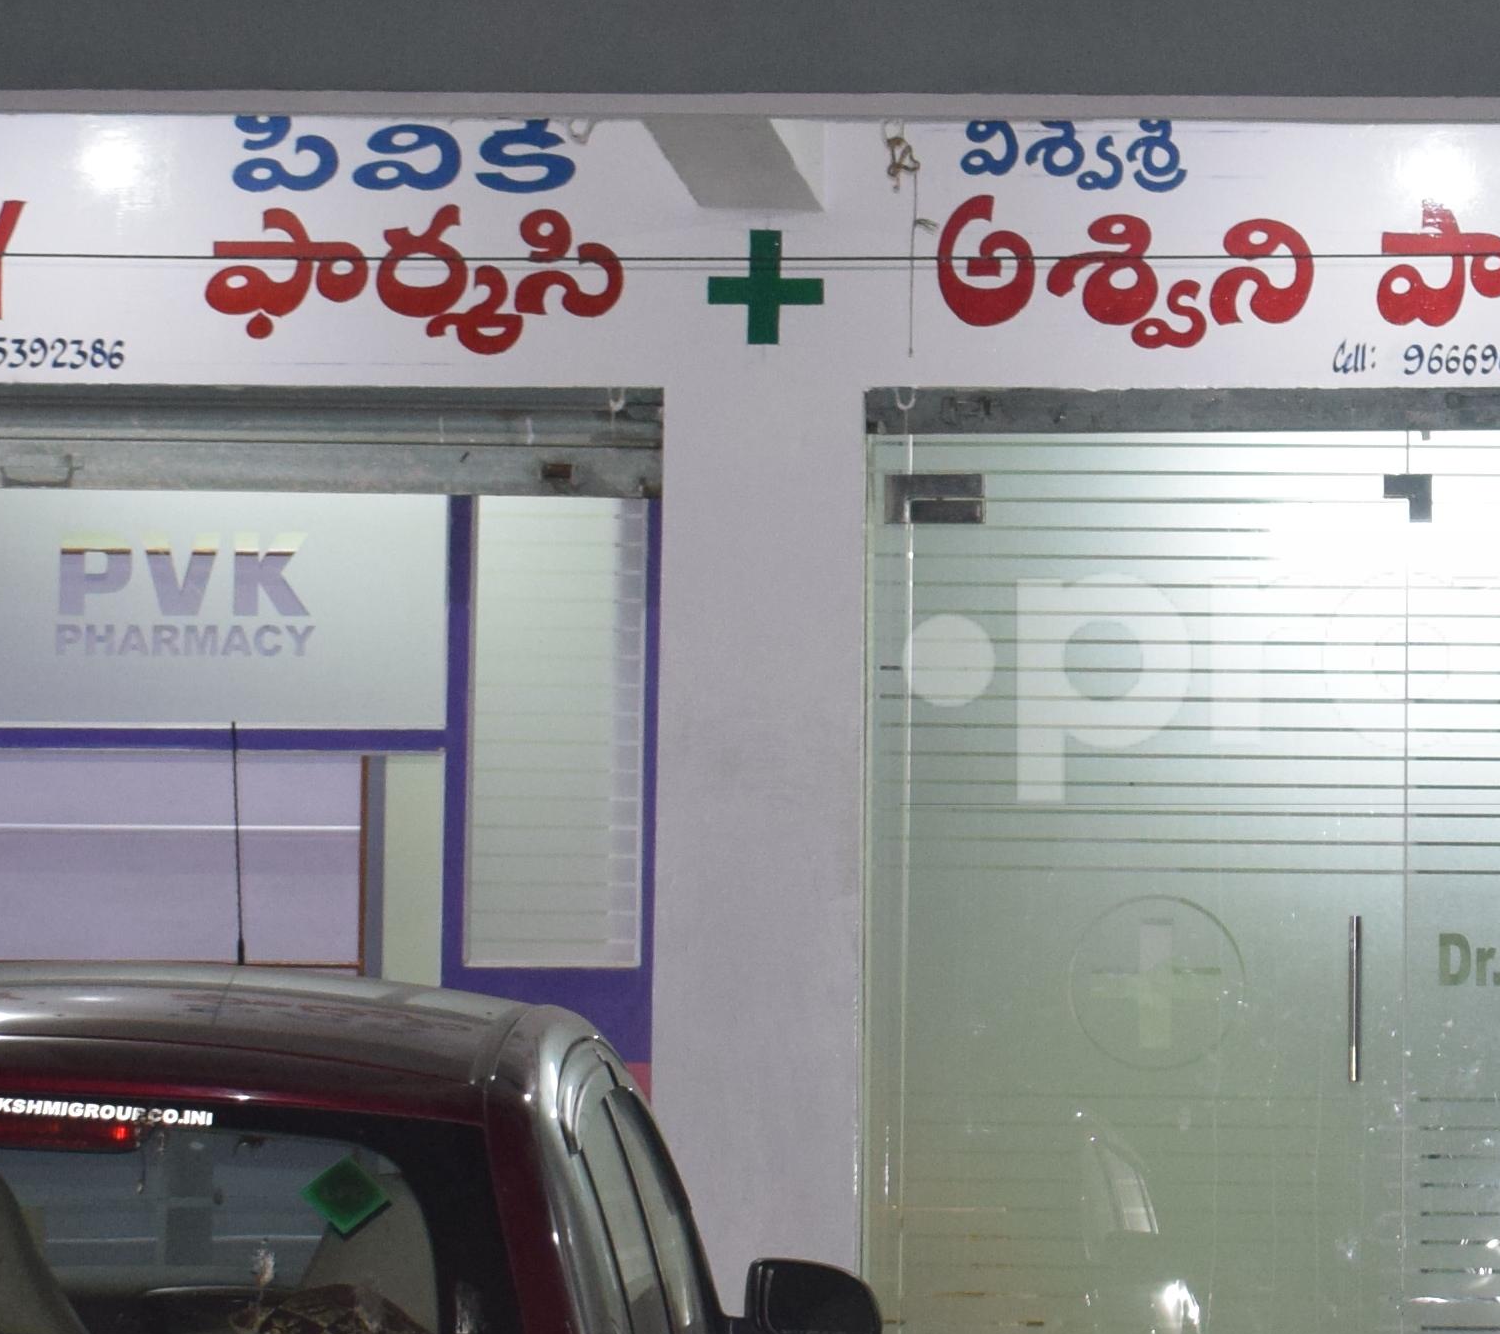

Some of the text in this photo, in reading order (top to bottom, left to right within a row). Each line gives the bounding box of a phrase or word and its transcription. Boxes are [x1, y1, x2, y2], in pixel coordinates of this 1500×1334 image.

[937, 194, 1317, 349] అశ్విని
[58, 531, 311, 617] PVK
[53, 623, 316, 658] PHARMACY
